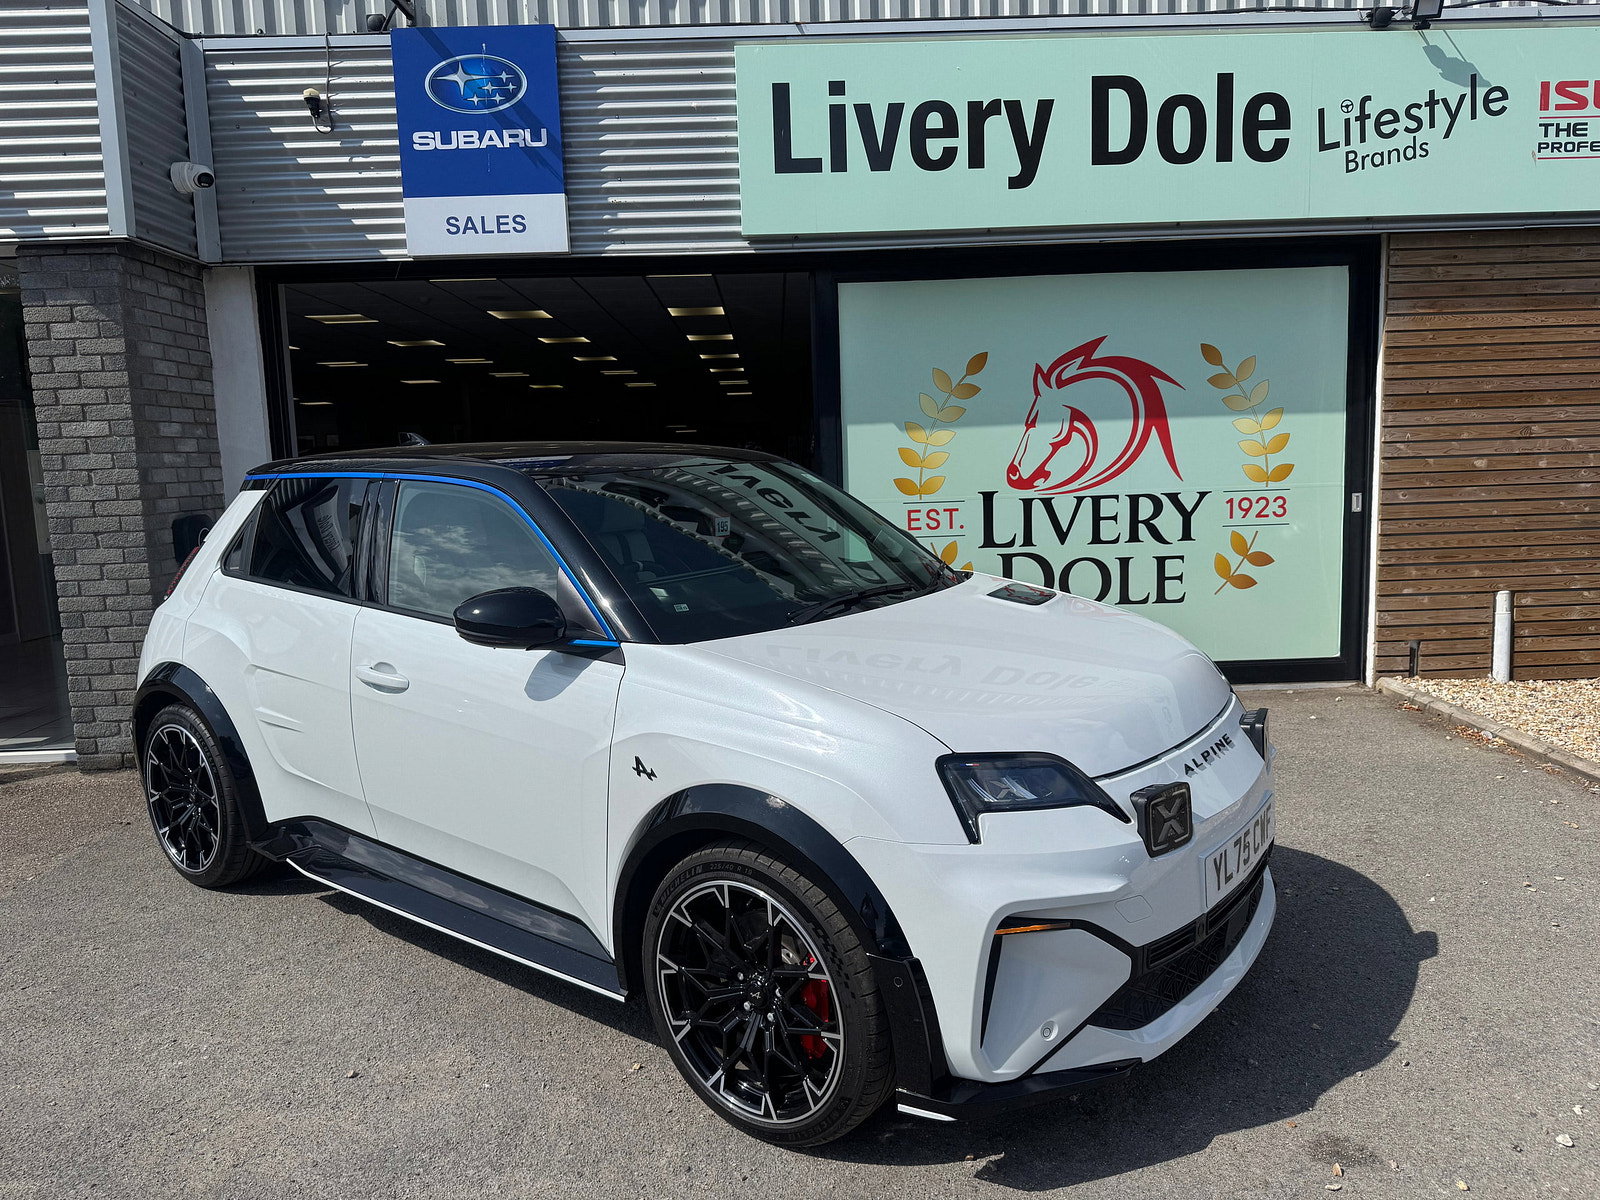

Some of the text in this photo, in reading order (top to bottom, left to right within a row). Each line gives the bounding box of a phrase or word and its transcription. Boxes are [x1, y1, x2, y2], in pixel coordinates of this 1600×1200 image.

[1317, 73, 1509, 152] Lifestyle
[1540, 80, 1600, 111] IS
[412, 127, 548, 151] SUBARU
[771, 72, 1292, 189] Livery Dole
[1538, 122, 1588, 138] THE
[1345, 135, 1430, 174] Brands
[445, 214, 528, 236] SALES
[906, 507, 965, 532] EST.
[977, 490, 1213, 549] LIVERY
[1225, 495, 1289, 521] 1923
[996, 552, 1187, 606] DOLE
[1183, 733, 1233, 776] ALPINE
[1213, 828, 1250, 892] YL75
[660, 864, 704, 905] MICHELIN
